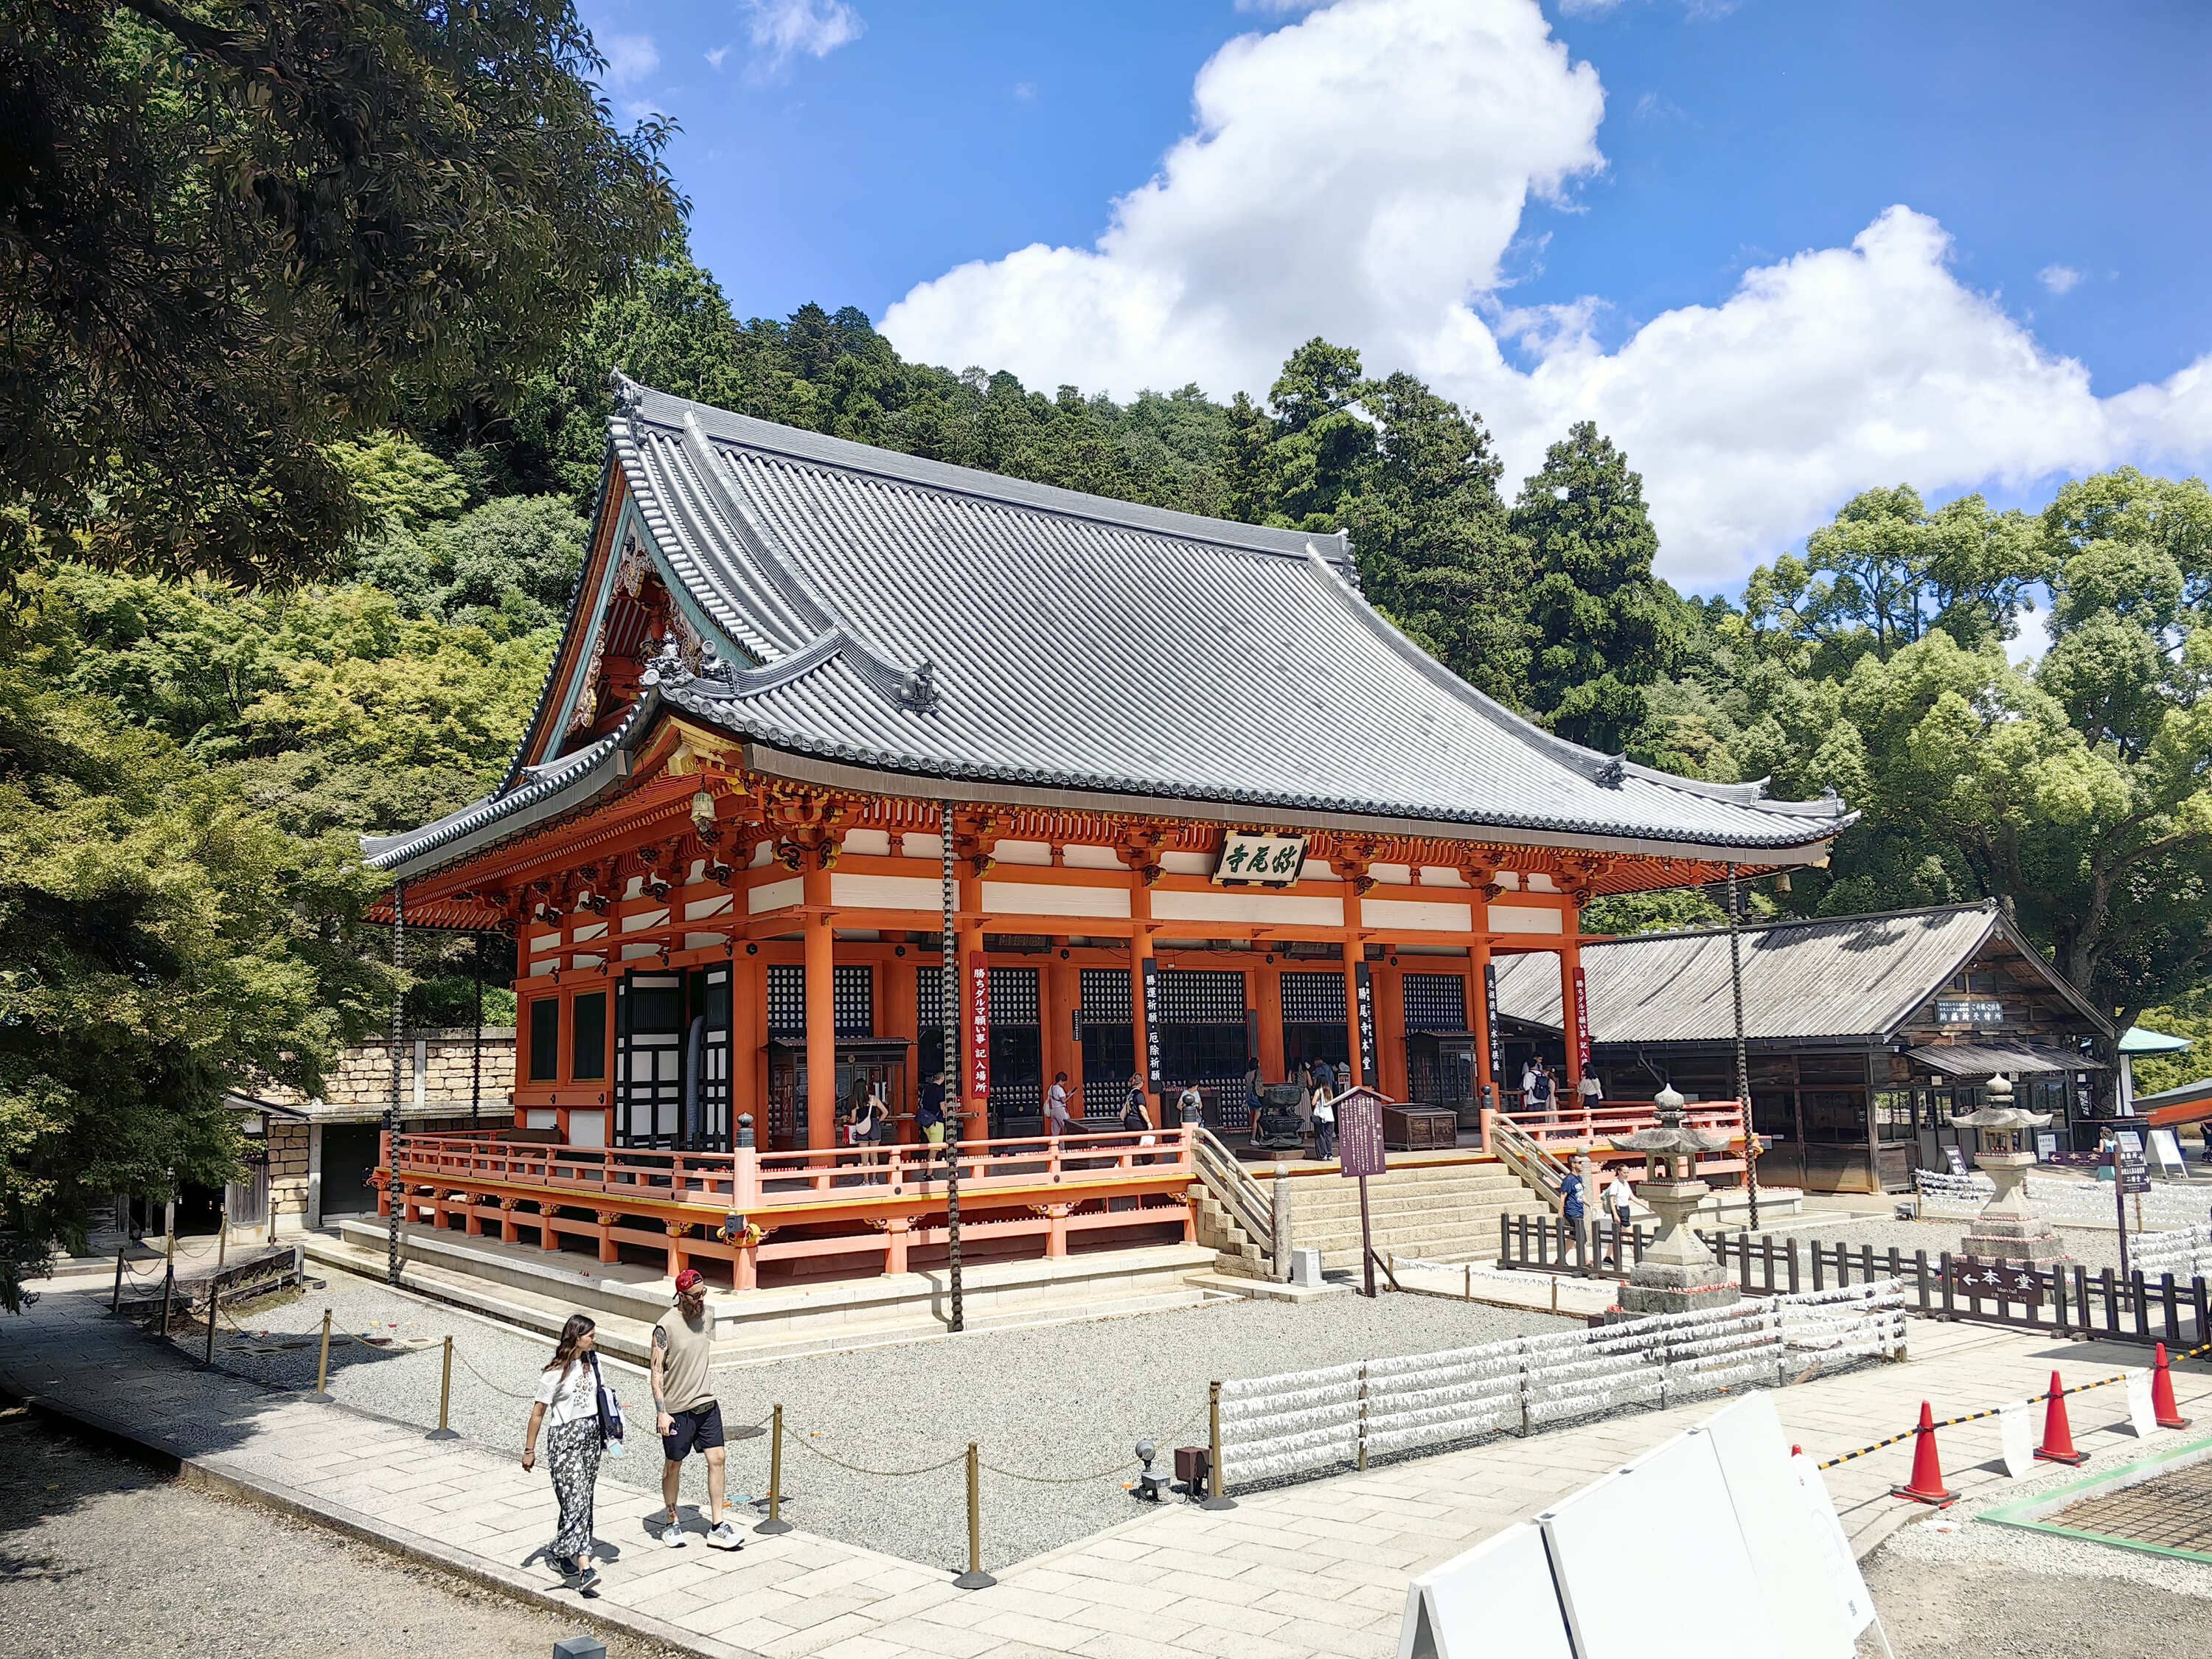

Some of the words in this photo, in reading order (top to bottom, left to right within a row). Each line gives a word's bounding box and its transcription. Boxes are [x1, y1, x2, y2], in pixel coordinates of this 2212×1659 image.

[973, 968, 987, 1045] 勝ちダルマ願い事
[975, 1048, 987, 1093] 記入場所
[1981, 1268, 2035, 1291] 本堂
